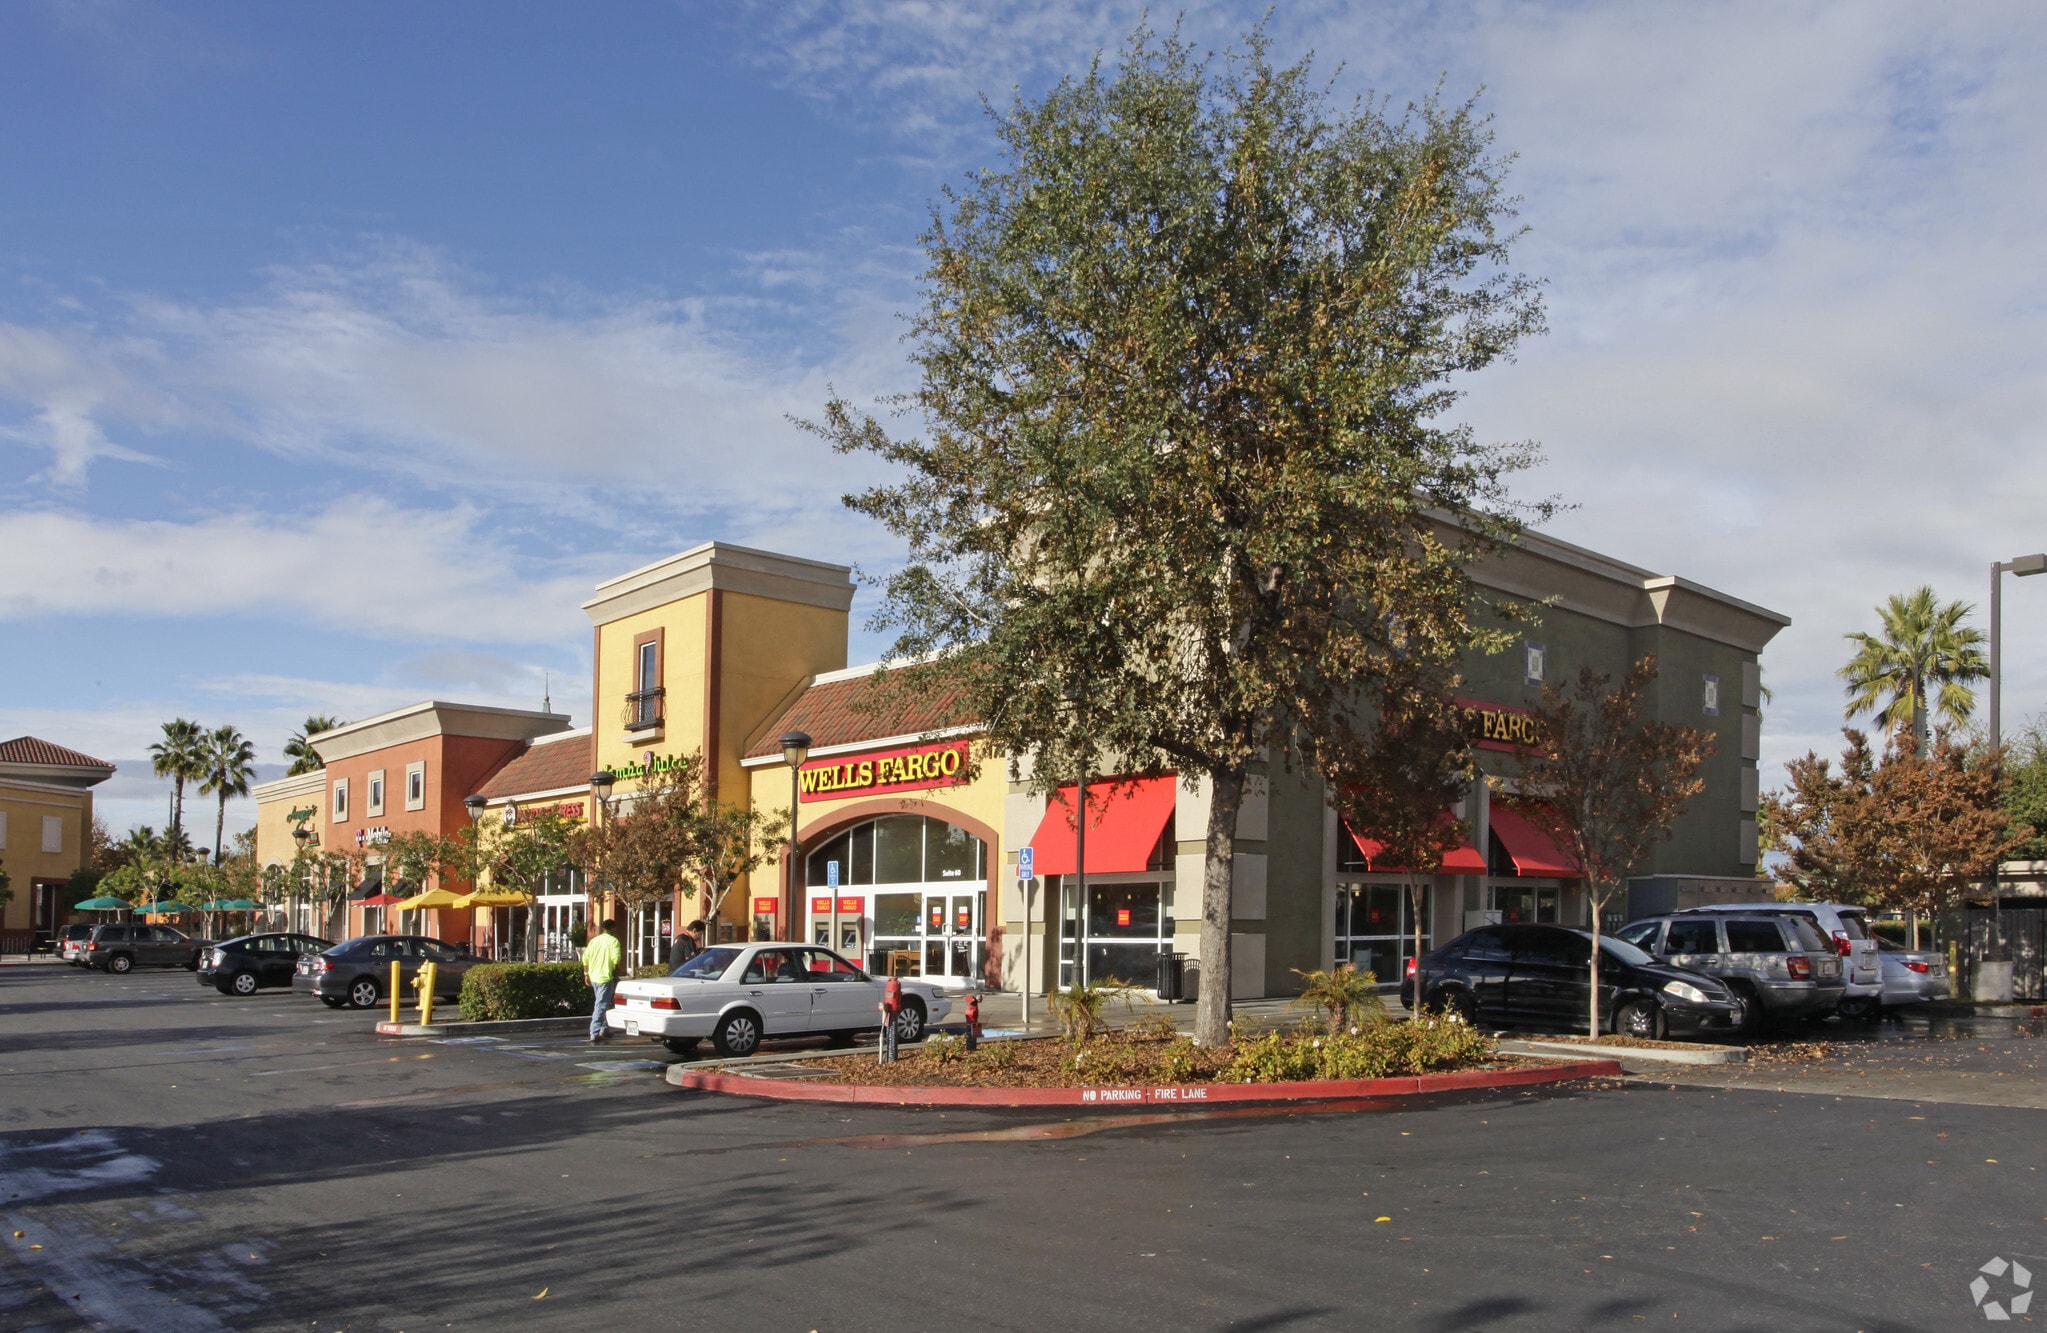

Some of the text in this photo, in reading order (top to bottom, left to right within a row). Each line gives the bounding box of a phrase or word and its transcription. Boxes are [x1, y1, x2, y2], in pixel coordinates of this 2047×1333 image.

[1481, 710, 1541, 744] FARG
[799, 748, 961, 793] WELLS FARGO
[1082, 1090, 1096, 1101] NO
[1100, 1089, 1142, 1100] PARKING
[1154, 1088, 1177, 1099] FIRE
[1181, 1088, 1208, 1099] LANE
